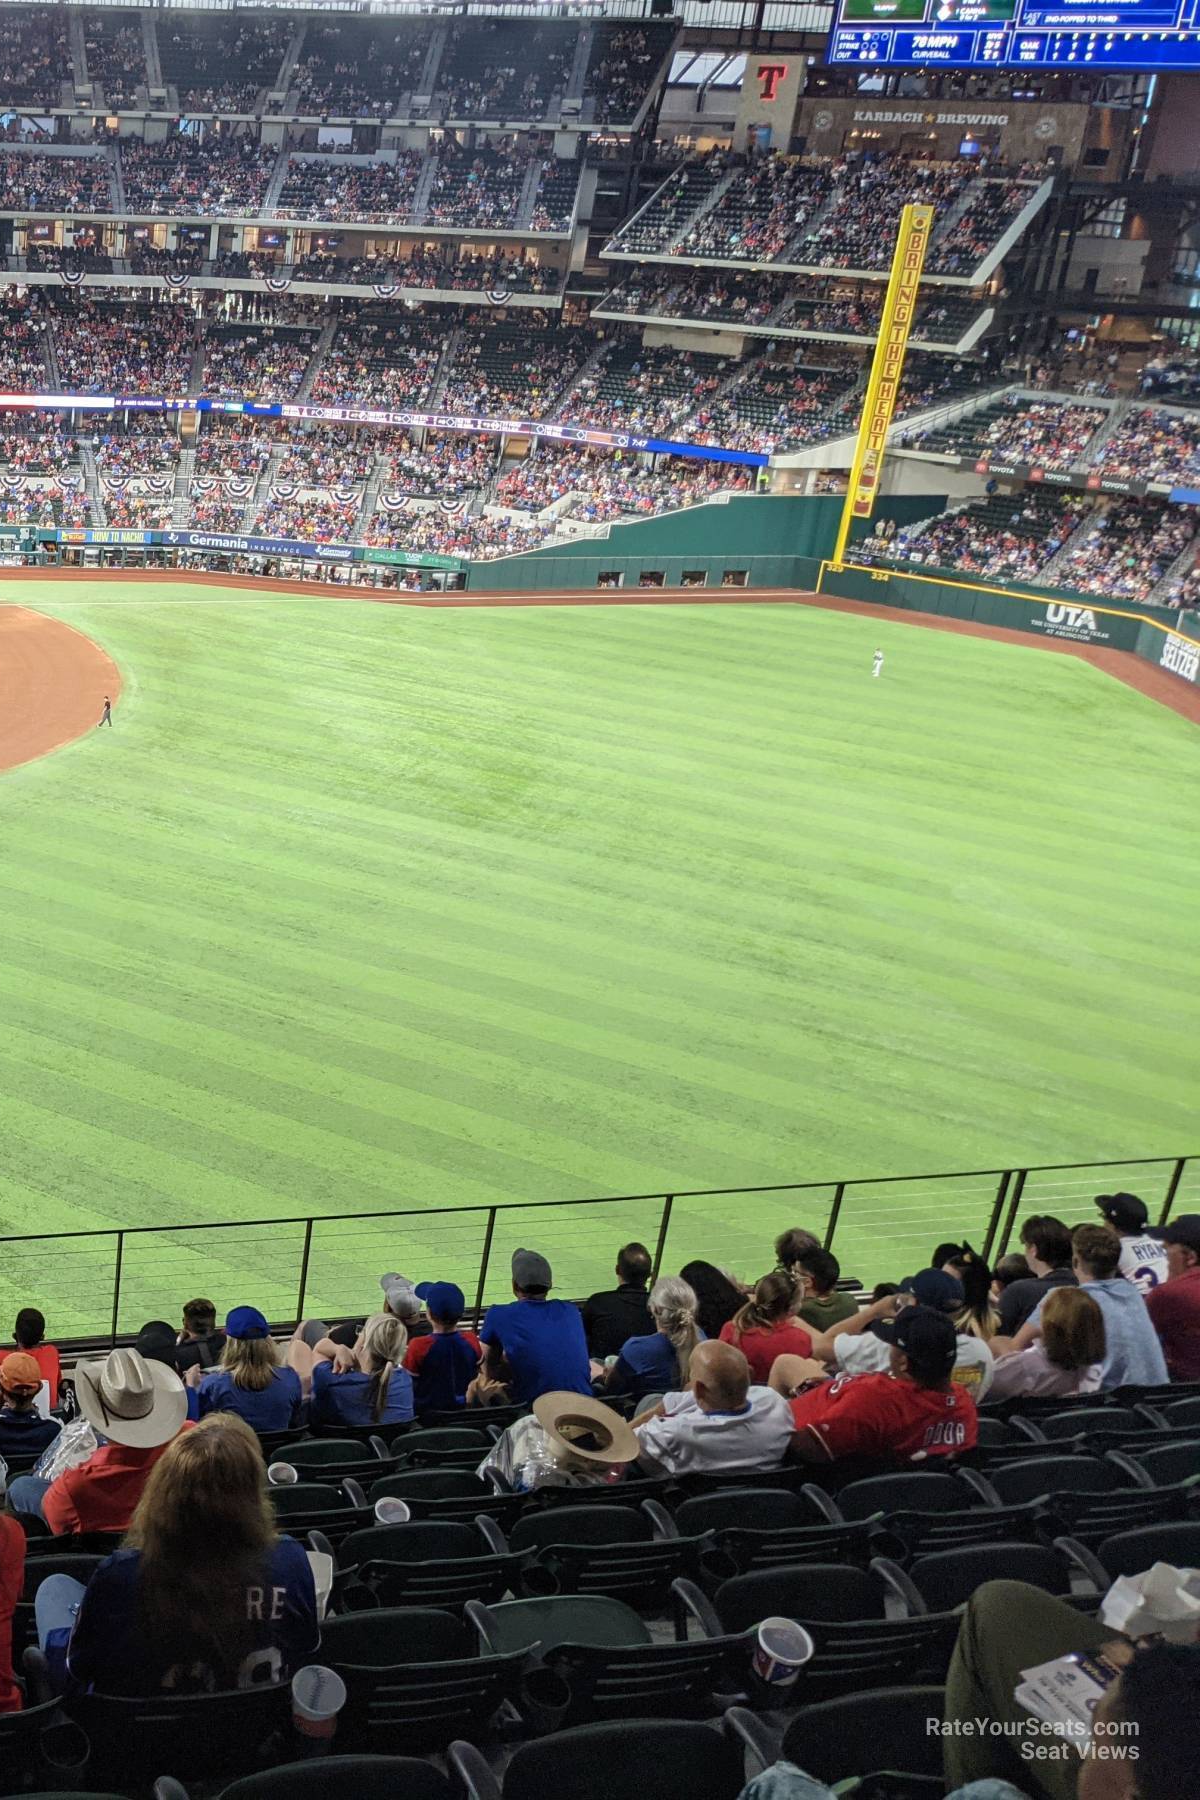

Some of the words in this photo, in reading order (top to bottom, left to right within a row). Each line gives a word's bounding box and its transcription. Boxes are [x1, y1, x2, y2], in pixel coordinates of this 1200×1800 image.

[840, 33, 855, 41] BALL
[927, 36, 958, 48] MPH
[1087, 42, 1094, 50] 0
[1105, 42, 1112, 51] 0
[912, 51, 950, 59] CURVEBALL
[1020, 52, 1036, 60] TEX
[1068, 53, 1076, 61] 0
[757, 64, 788, 101] T
[853, 111, 923, 122] KARBACH
[937, 115, 1009, 126] BREWING
[896, 234, 922, 320] BRING
[885, 328, 904, 376] THE
[871, 383, 892, 448] HEAT
[632, 439, 647, 447] 7:47
[989, 466, 1015, 475] TOYOTA
[1044, 473, 1072, 482] TOYOTA
[1101, 480, 1129, 490] TOYOTA
[92, 531, 108, 542] HOW
[110, 531, 119, 542] TO
[189, 534, 248, 549] Germania
[250, 545, 300, 554] INSURANCE
[871, 572, 889, 581] 334
[1046, 603, 1096, 630] UTA
[1031, 619, 1043, 627] THE
[1044, 621, 1079, 633] UNIVERSITY
[1055, 630, 1090, 640] ARLINGTON
[1160, 643, 1199, 682] SELTZER
